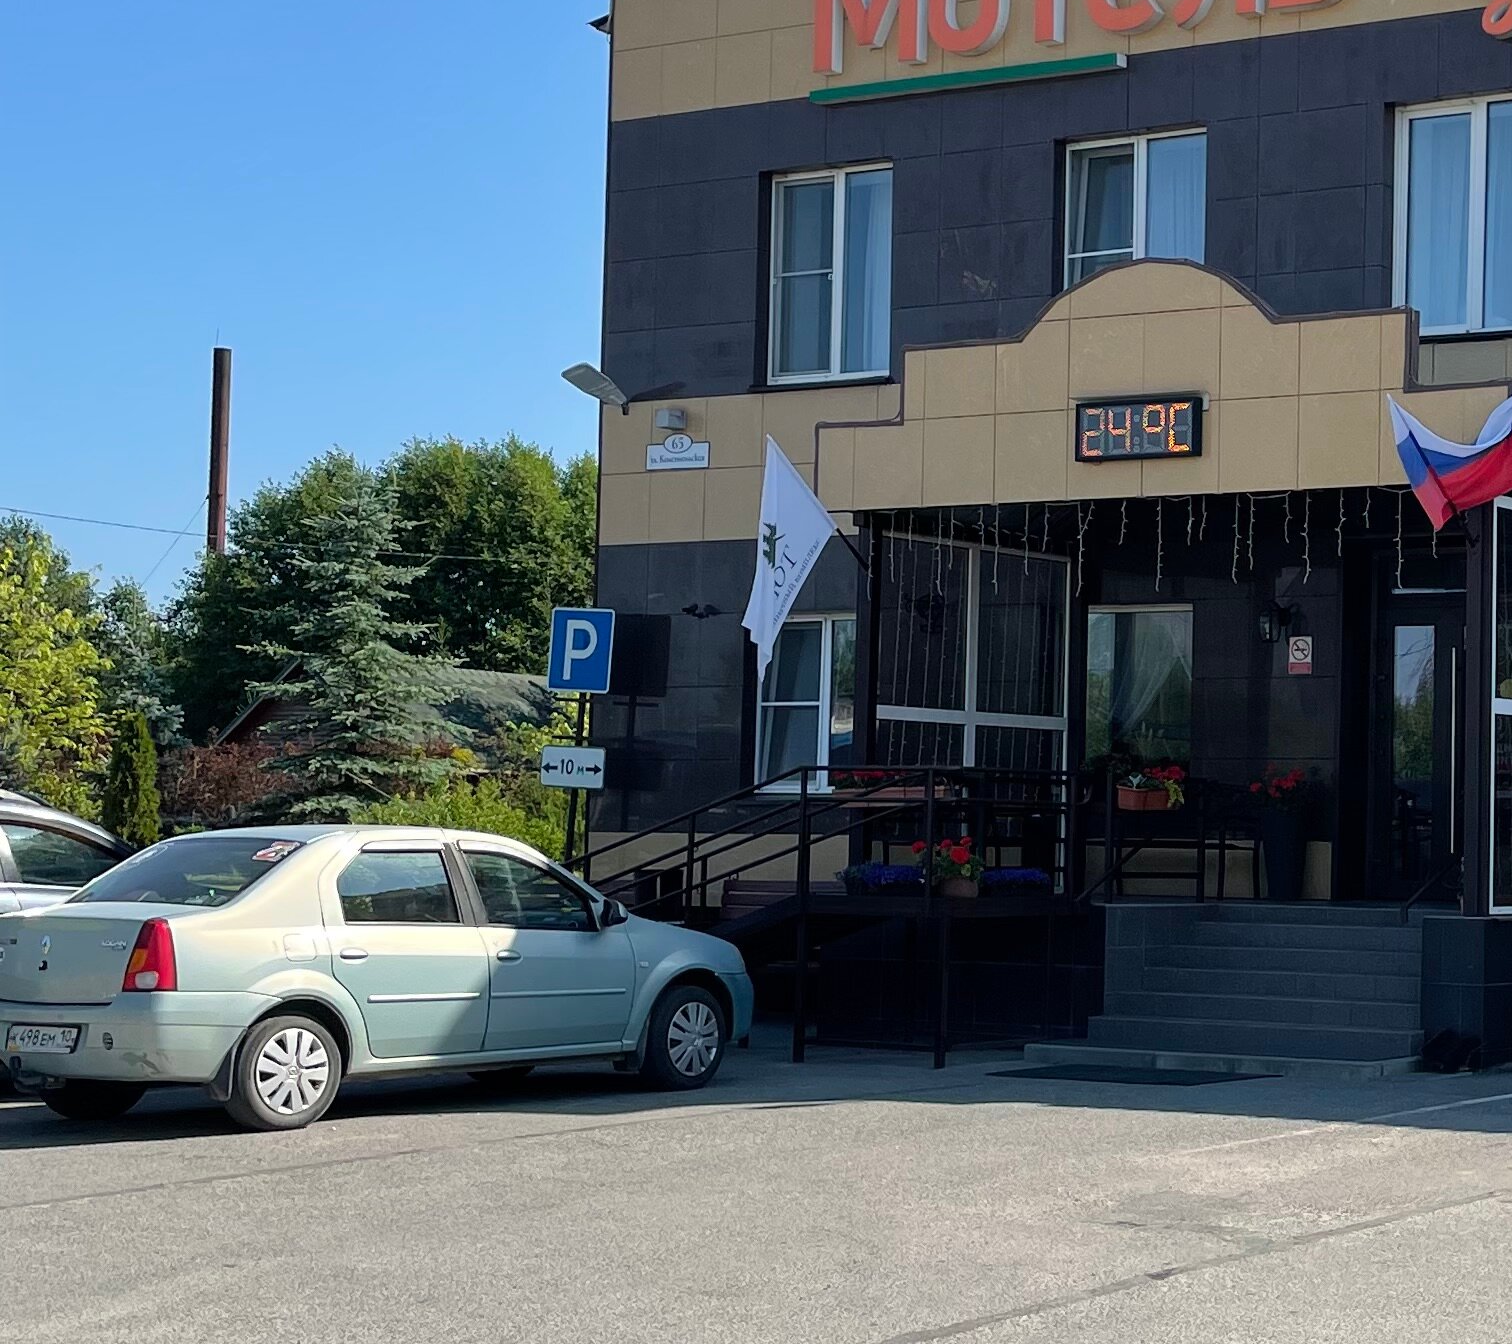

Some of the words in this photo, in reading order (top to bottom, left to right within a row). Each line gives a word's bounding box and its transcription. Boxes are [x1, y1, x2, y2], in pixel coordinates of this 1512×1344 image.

[671, 436, 684, 450] 65
[562, 618, 598, 681] P
[560, 758, 574, 775] 10
[60, 1029, 73, 1042] 10
